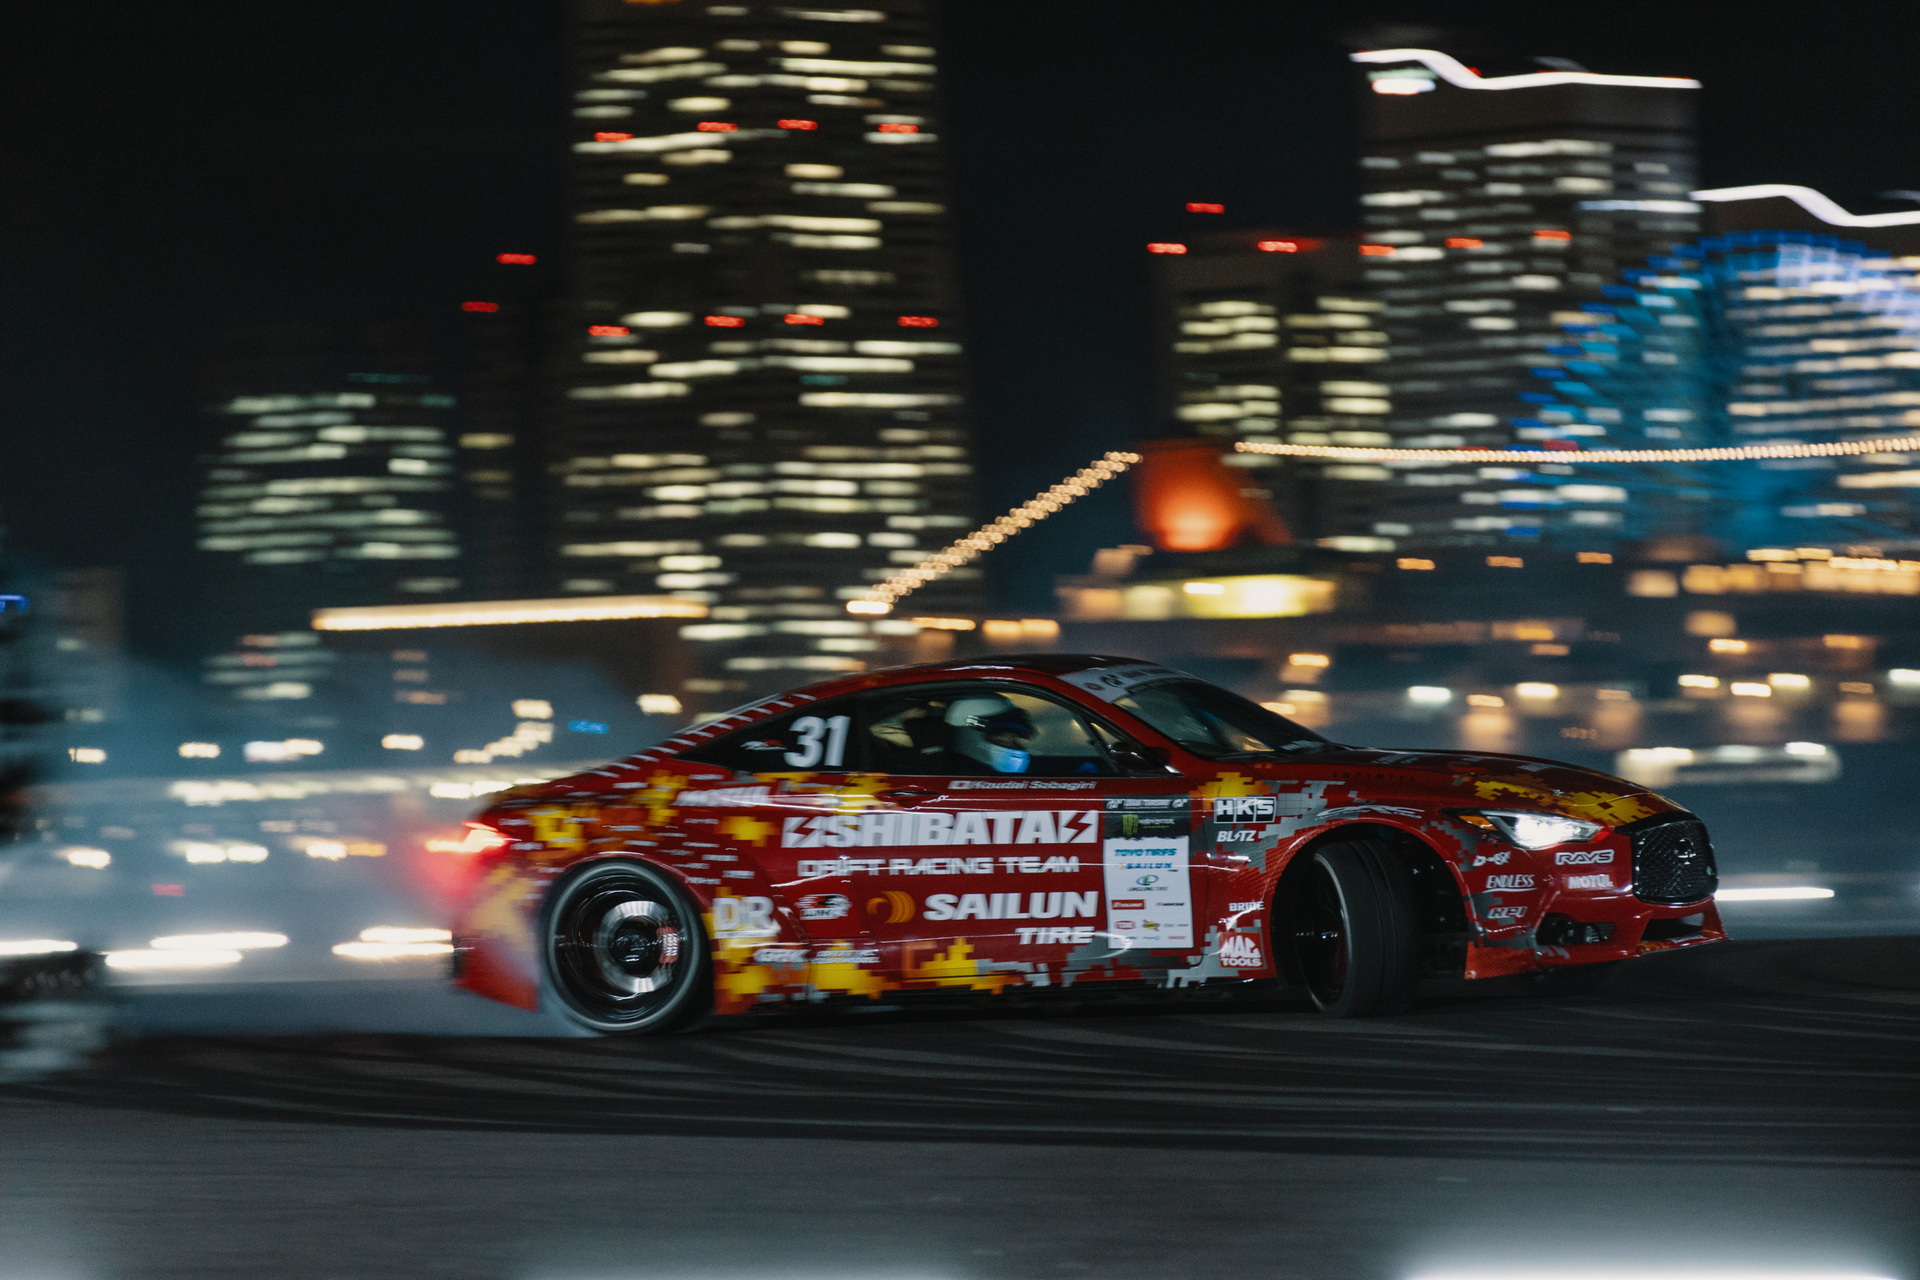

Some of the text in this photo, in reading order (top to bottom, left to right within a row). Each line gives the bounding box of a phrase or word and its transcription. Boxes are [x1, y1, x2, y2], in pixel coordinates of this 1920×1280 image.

[783, 715, 852, 768] 31
[1216, 799, 1274, 816] HKS
[825, 811, 1058, 848] SHIBATA
[1216, 830, 1257, 842] BLITZ
[1555, 849, 1615, 866] RAYS
[797, 855, 1080, 878] DRIFT RACING TEAM
[1486, 874, 1535, 888] ENDLESS
[1568, 874, 1614, 889] MOTUL
[923, 891, 1099, 921] SAILUN
[1228, 901, 1265, 911] BRIDE
[1015, 926, 1096, 945] TIRE
[1221, 935, 1261, 958] MAC
[1220, 958, 1262, 967] TOOLS
